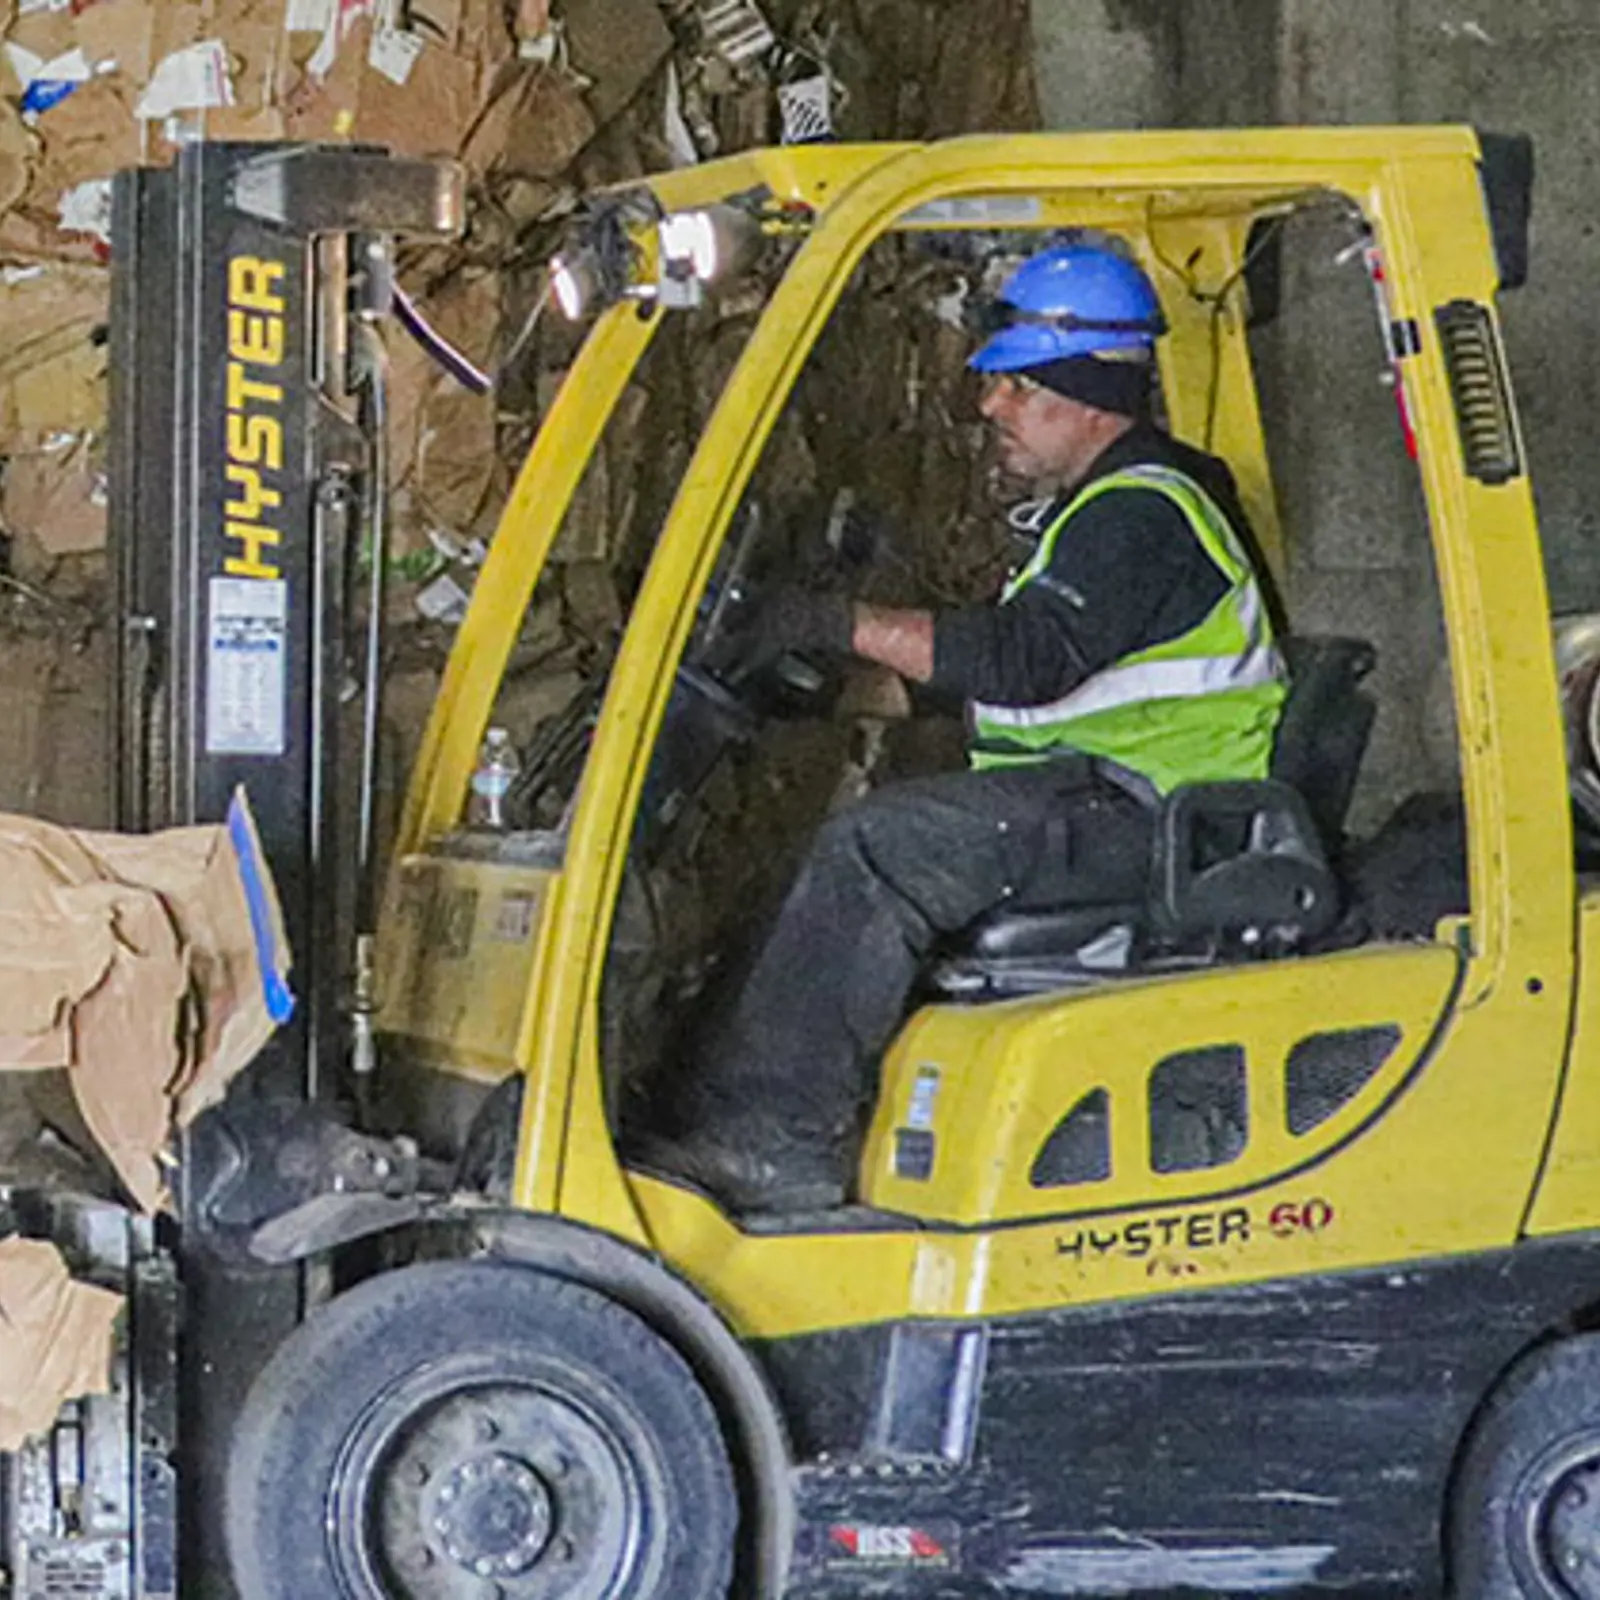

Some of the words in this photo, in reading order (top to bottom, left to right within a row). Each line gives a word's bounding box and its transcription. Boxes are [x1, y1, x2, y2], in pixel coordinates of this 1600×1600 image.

[224, 256, 284, 579] HYSTER
[1054, 1208, 1251, 1259] HYSTER
[1268, 1197, 1335, 1238] 60
